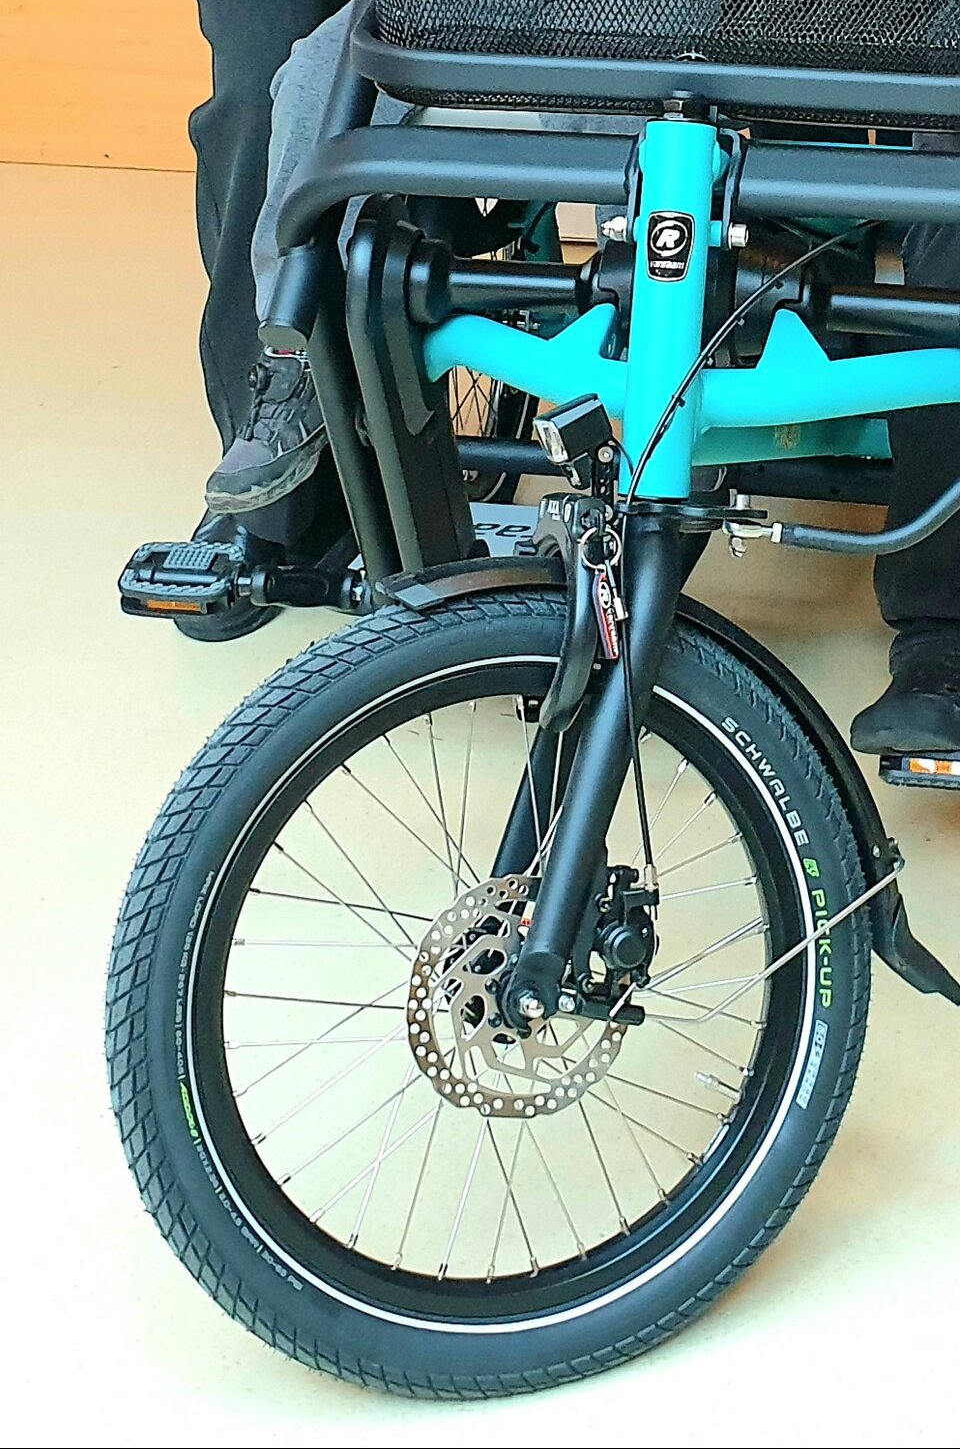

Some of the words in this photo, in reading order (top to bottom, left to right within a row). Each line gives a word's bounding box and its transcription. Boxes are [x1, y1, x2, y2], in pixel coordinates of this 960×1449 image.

[655, 228, 681, 248] R
[721, 716, 810, 846] SCHWALBE
[189, 896, 204, 929] LOAD
[811, 889, 833, 1008] PICK-UP
